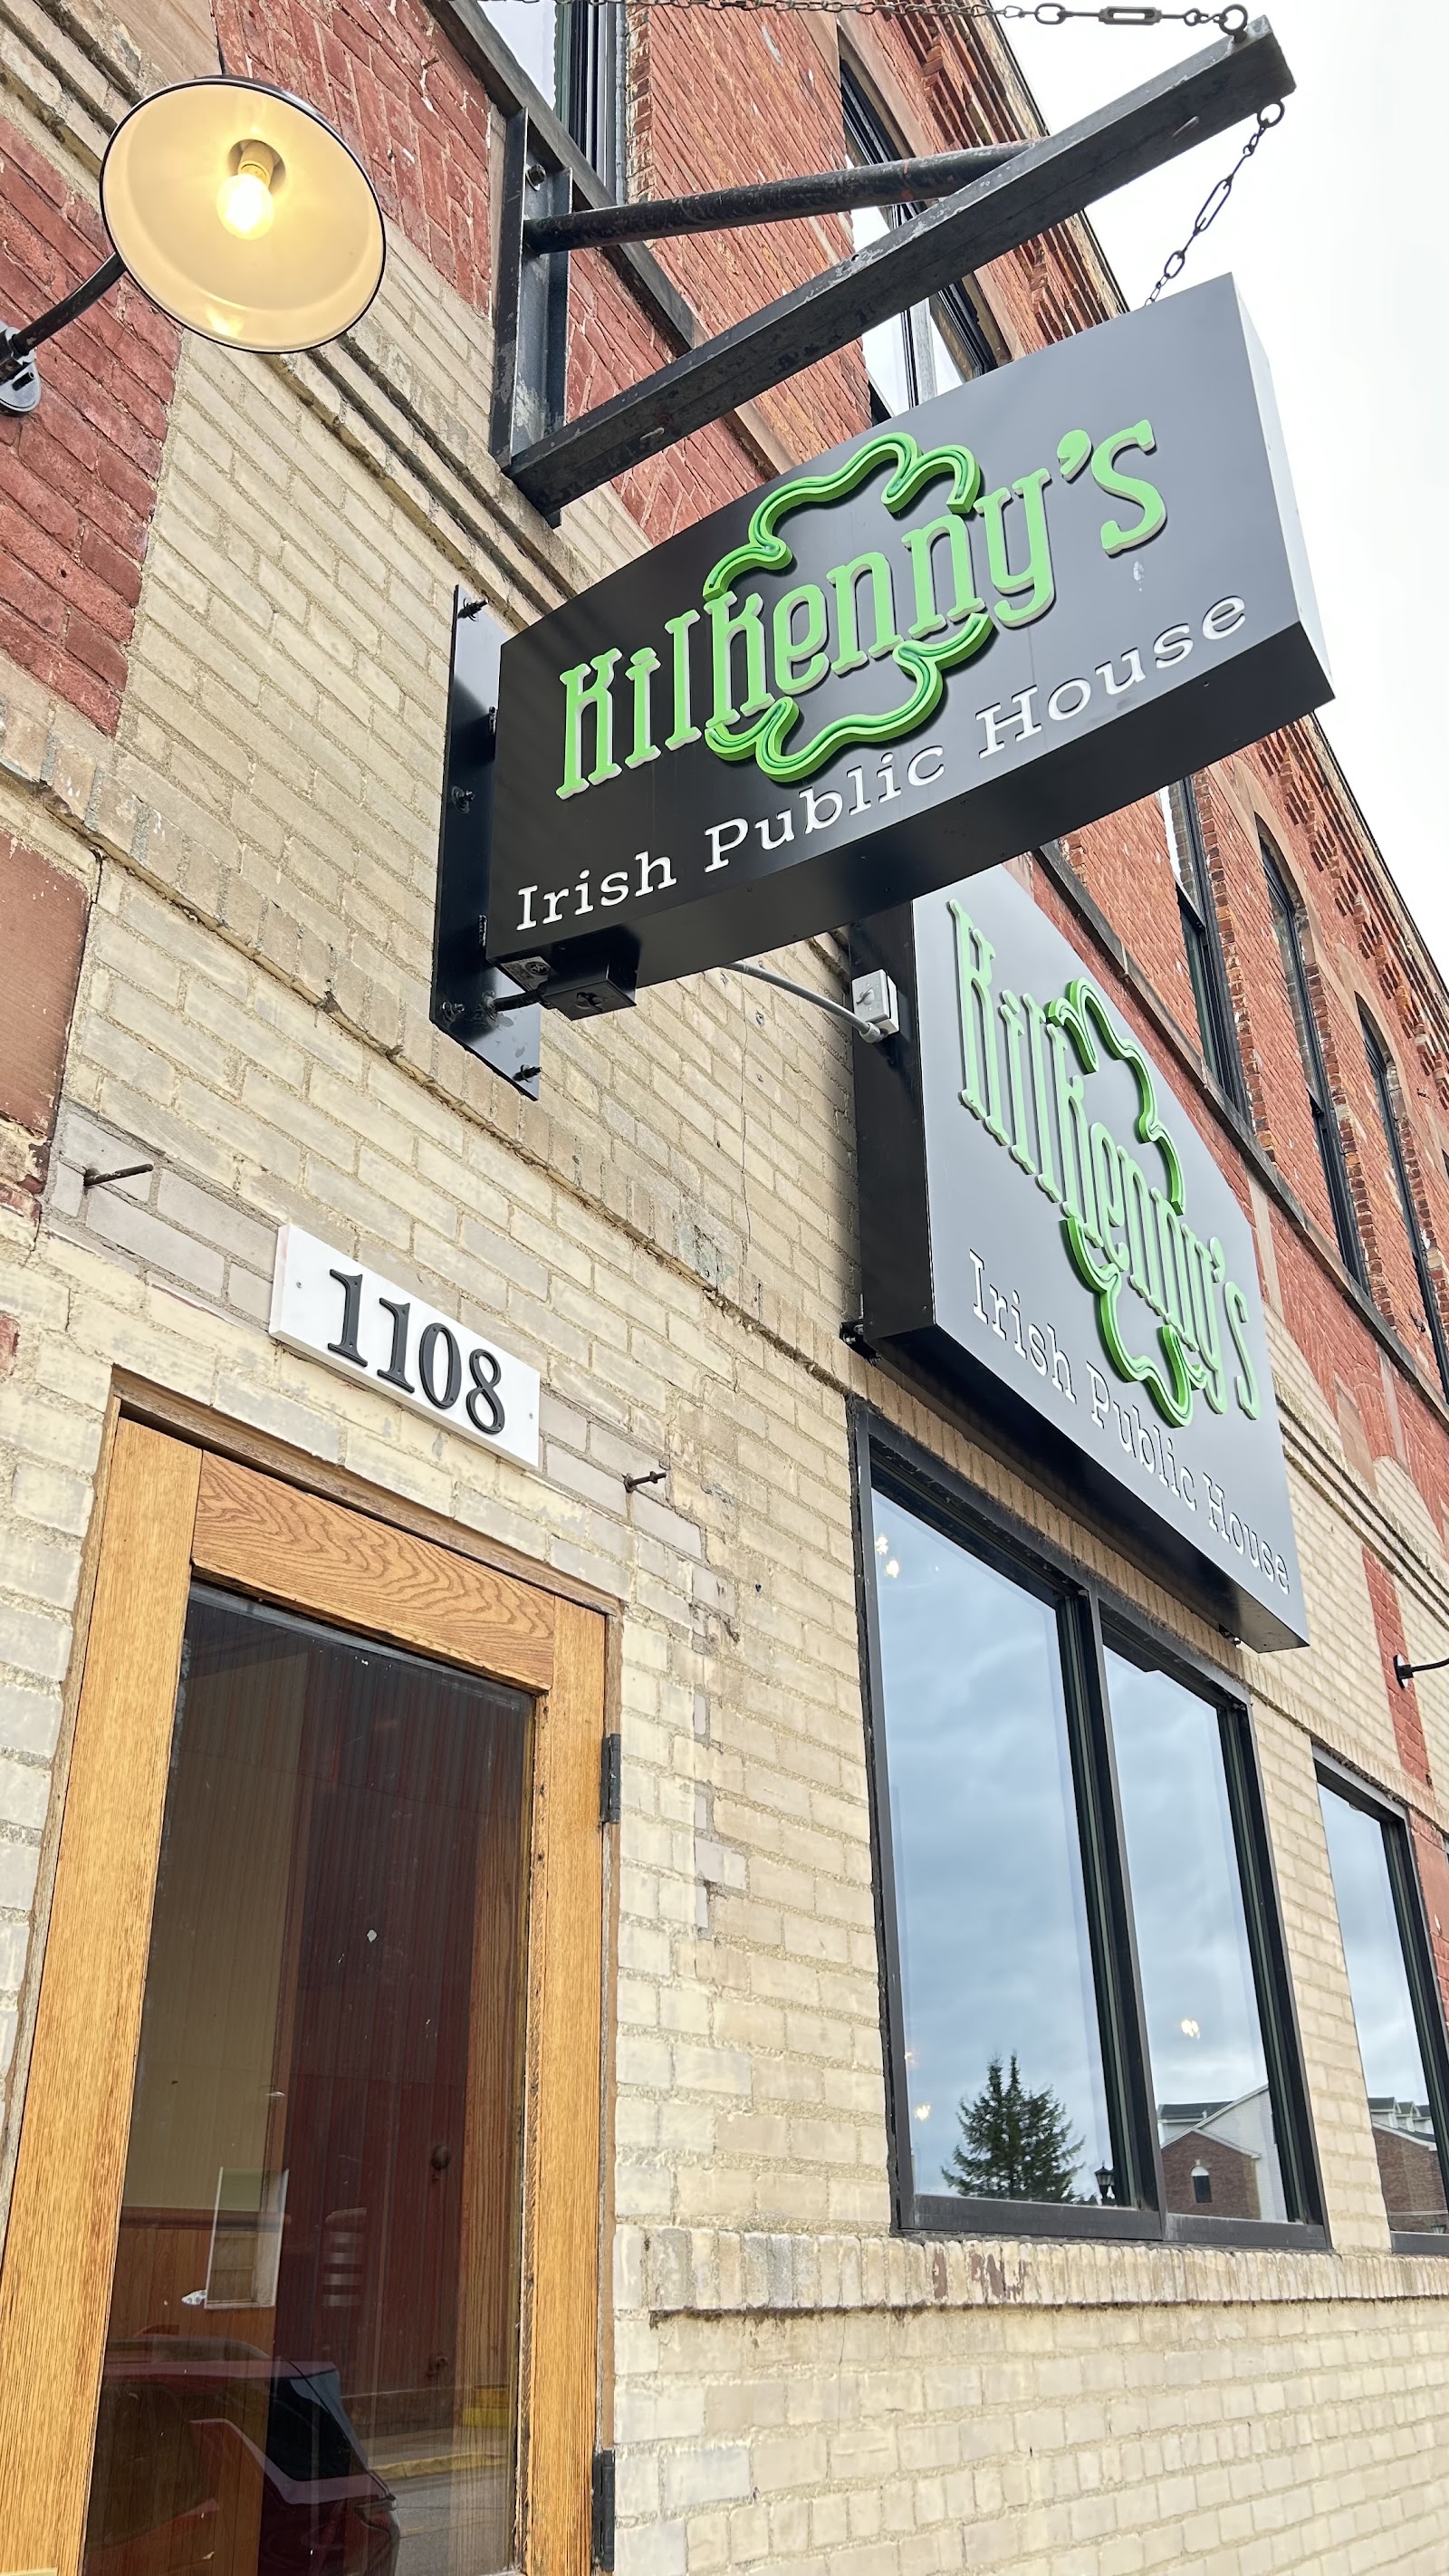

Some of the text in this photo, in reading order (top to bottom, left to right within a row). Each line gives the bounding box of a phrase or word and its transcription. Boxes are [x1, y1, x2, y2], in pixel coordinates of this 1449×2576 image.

[516, 596, 1247, 931] Irish Public House
[328, 1269, 505, 1435] 1108
[969, 1249, 1291, 1594] Irish Public House
